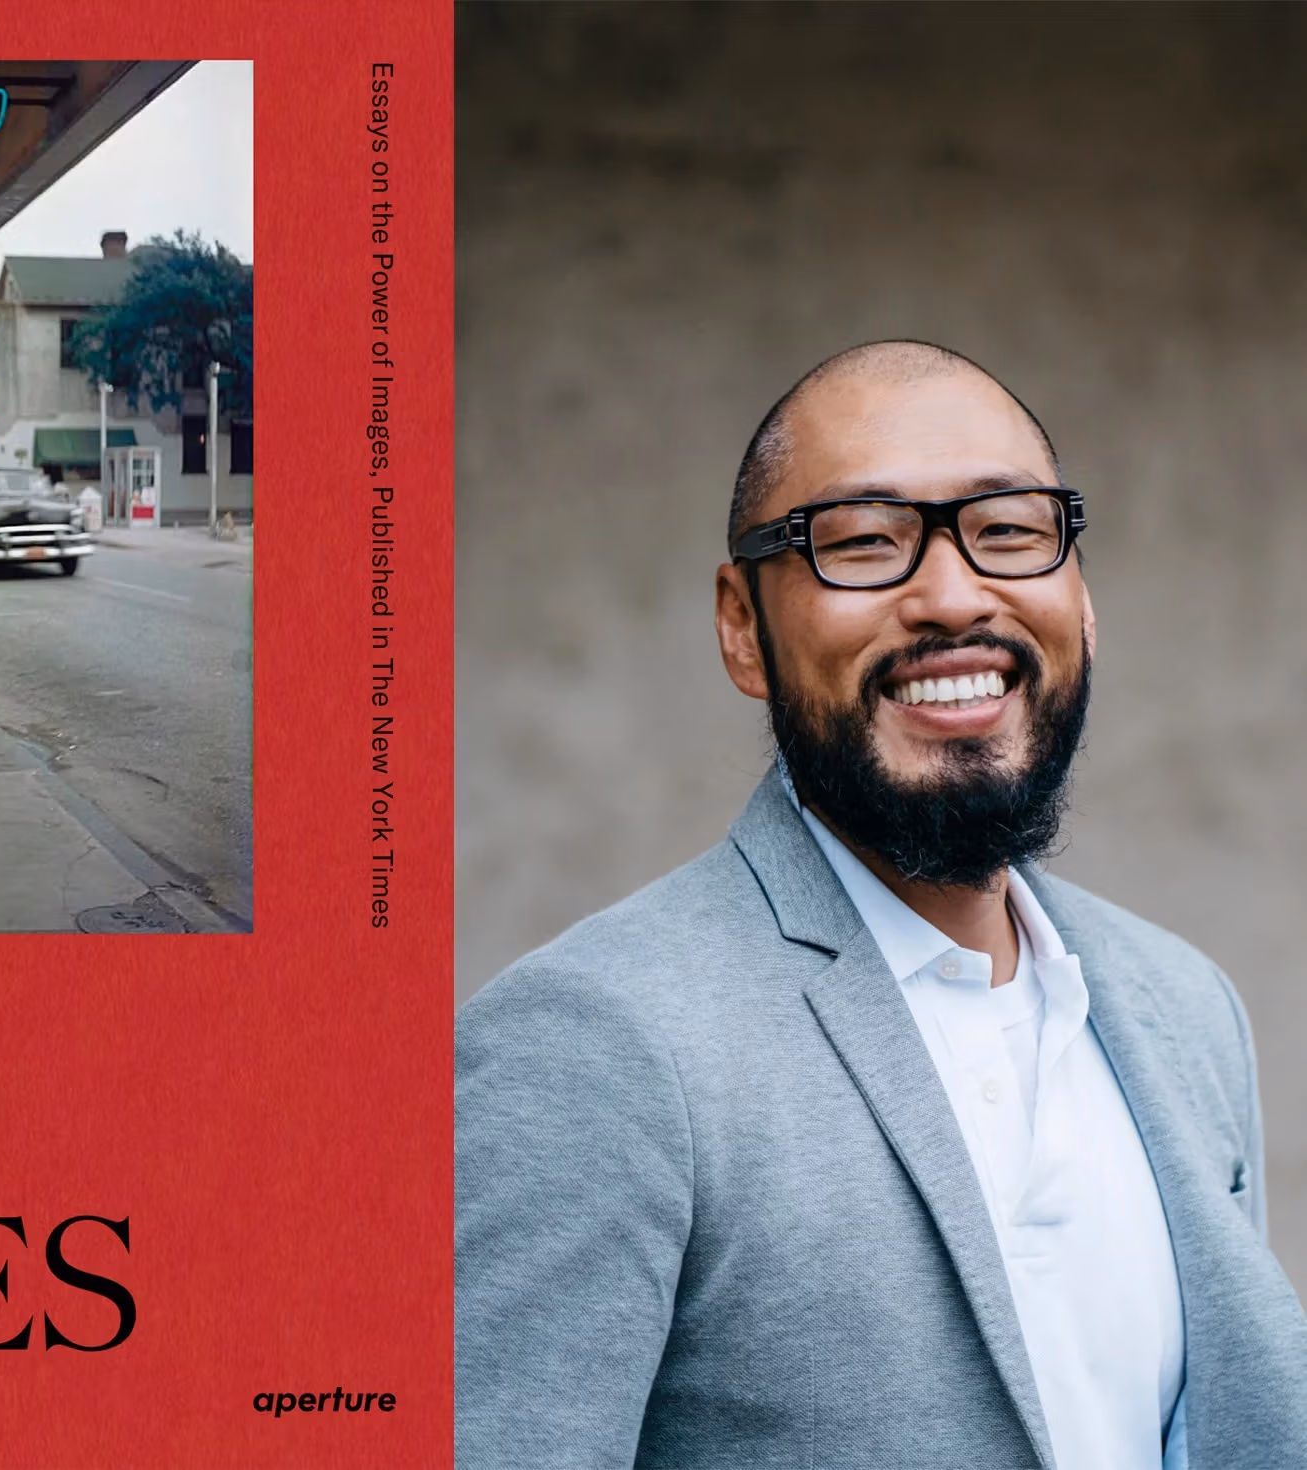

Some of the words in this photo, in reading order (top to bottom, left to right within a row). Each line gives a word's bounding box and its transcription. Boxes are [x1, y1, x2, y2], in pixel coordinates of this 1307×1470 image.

[367, 64, 394, 152] Essays
[371, 162, 389, 192] on
[371, 202, 394, 243] the
[371, 254, 394, 334] Power
[371, 342, 394, 367] of
[366, 377, 394, 476] Images,
[371, 487, 394, 616] Published
[371, 627, 394, 649] in
[371, 657, 394, 706] The
[371, 717, 394, 774] New
[371, 782, 394, 842] York
[371, 849, 394, 929] Times
[252, 1386, 397, 1418] aperture
